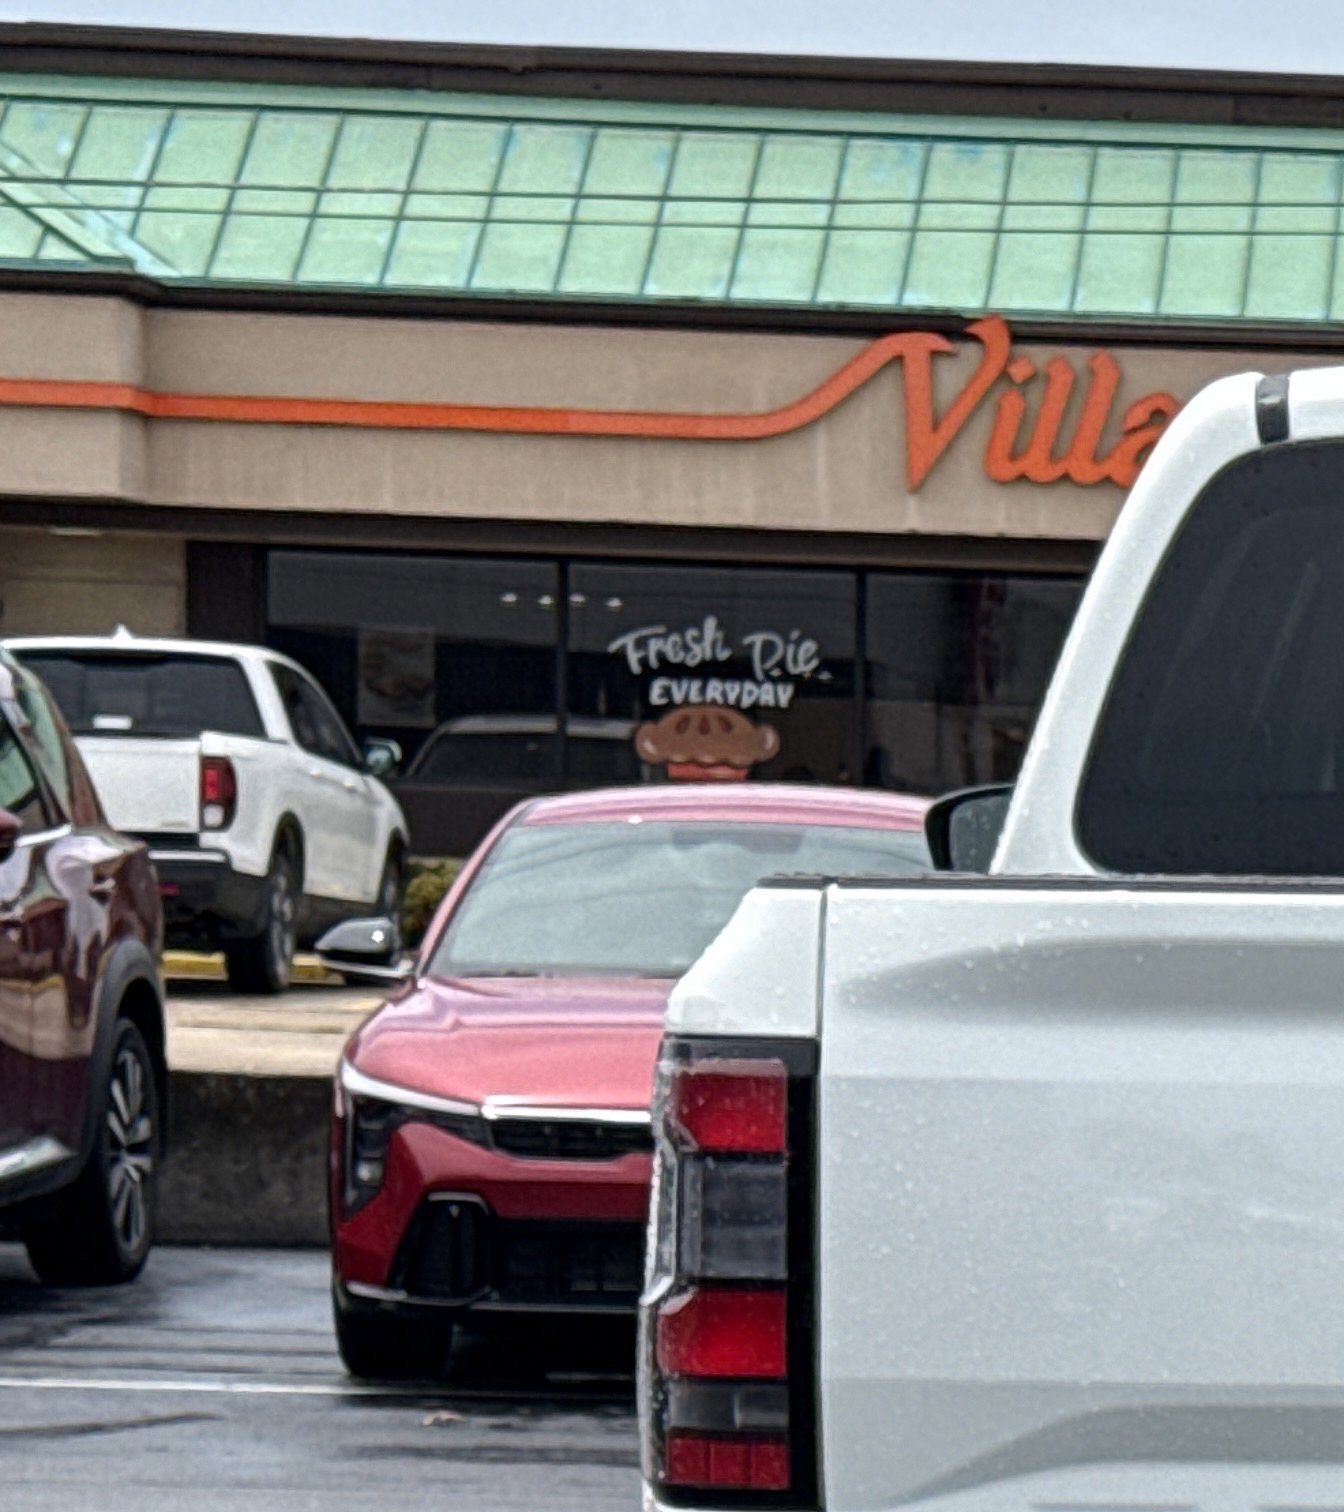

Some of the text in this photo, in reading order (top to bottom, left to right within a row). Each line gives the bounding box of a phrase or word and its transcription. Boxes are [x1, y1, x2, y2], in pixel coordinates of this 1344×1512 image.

[607, 615, 821, 681] Fresh Pie
[649, 677, 794, 708] EVERYDAY
